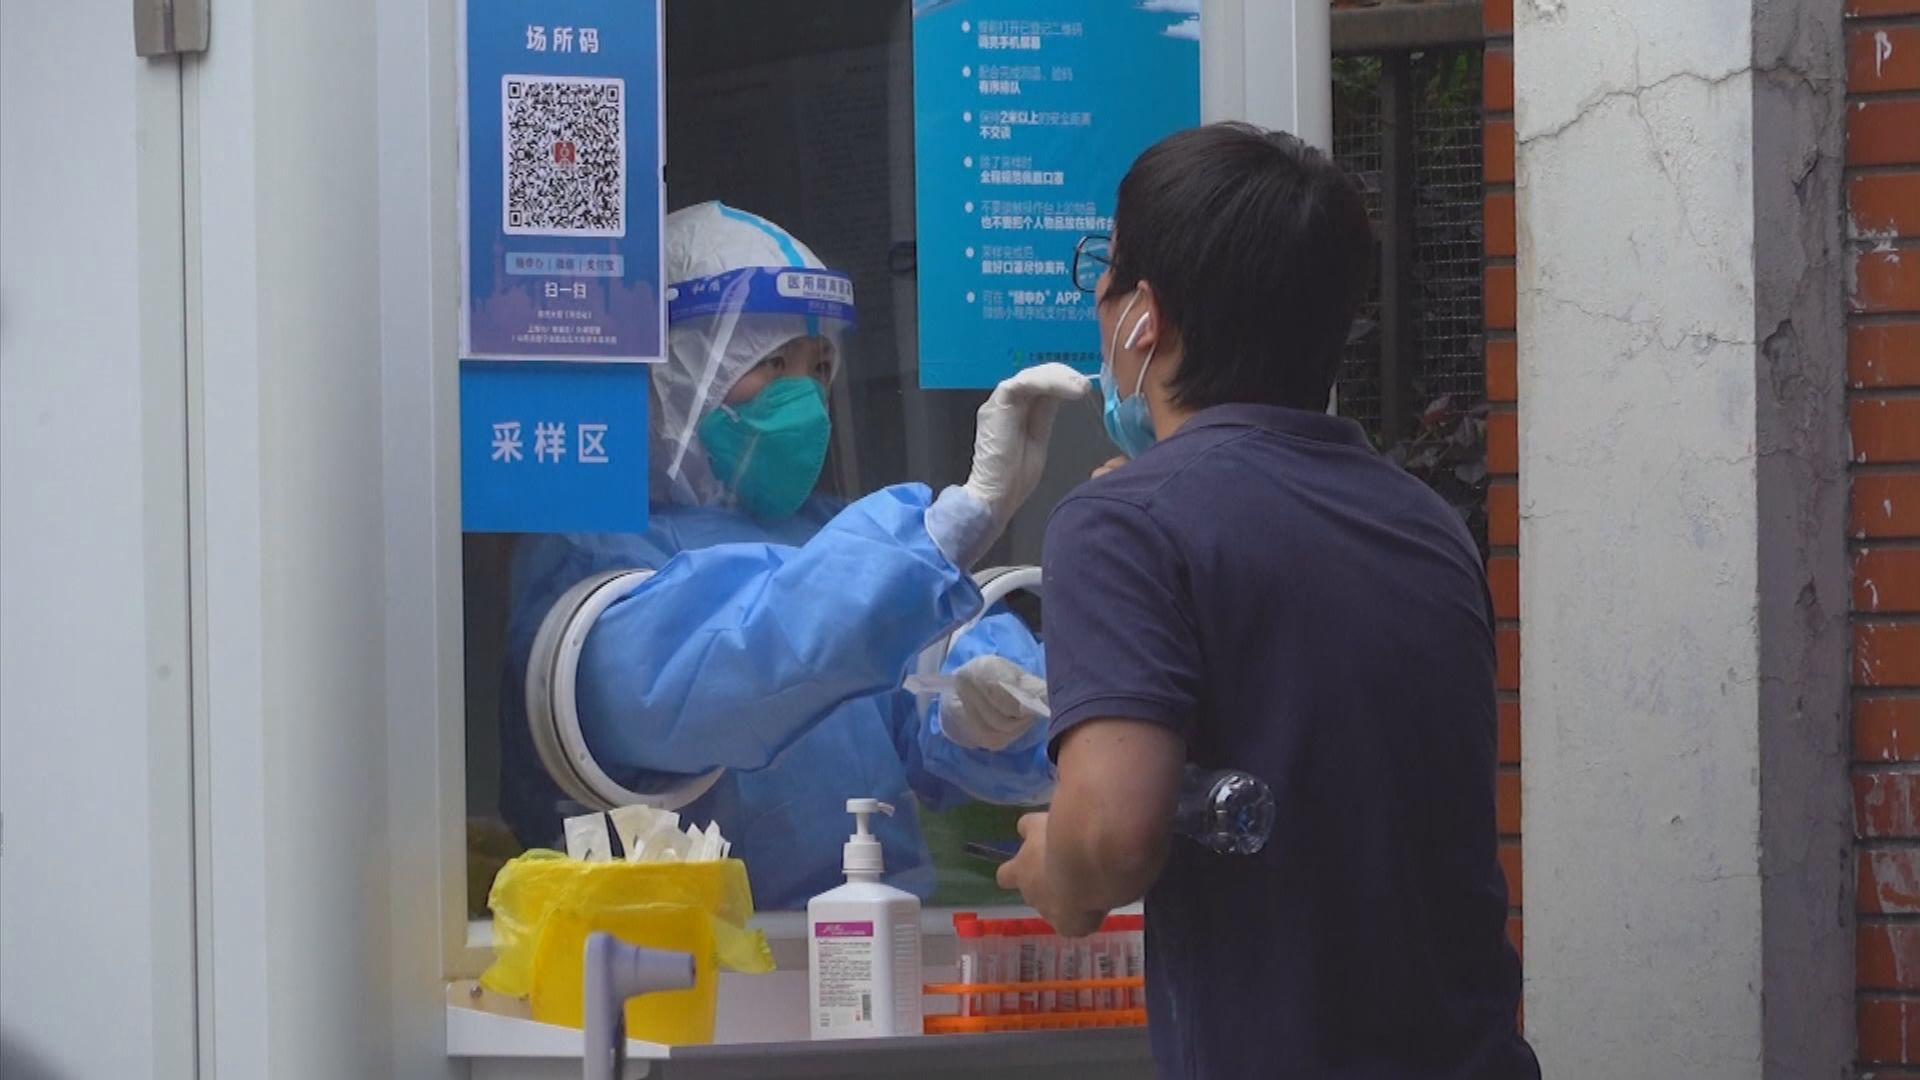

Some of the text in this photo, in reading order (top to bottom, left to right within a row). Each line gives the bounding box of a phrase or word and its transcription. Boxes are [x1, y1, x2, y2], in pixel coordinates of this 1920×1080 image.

[525, 24, 599, 54] 场所码
[980, 126, 1011, 139] 不交谈
[586, 259, 615, 272] 支付宝
[545, 281, 587, 299] 扫一扫
[1055, 292, 1081, 305] APP
[491, 422, 609, 463] 采样区
